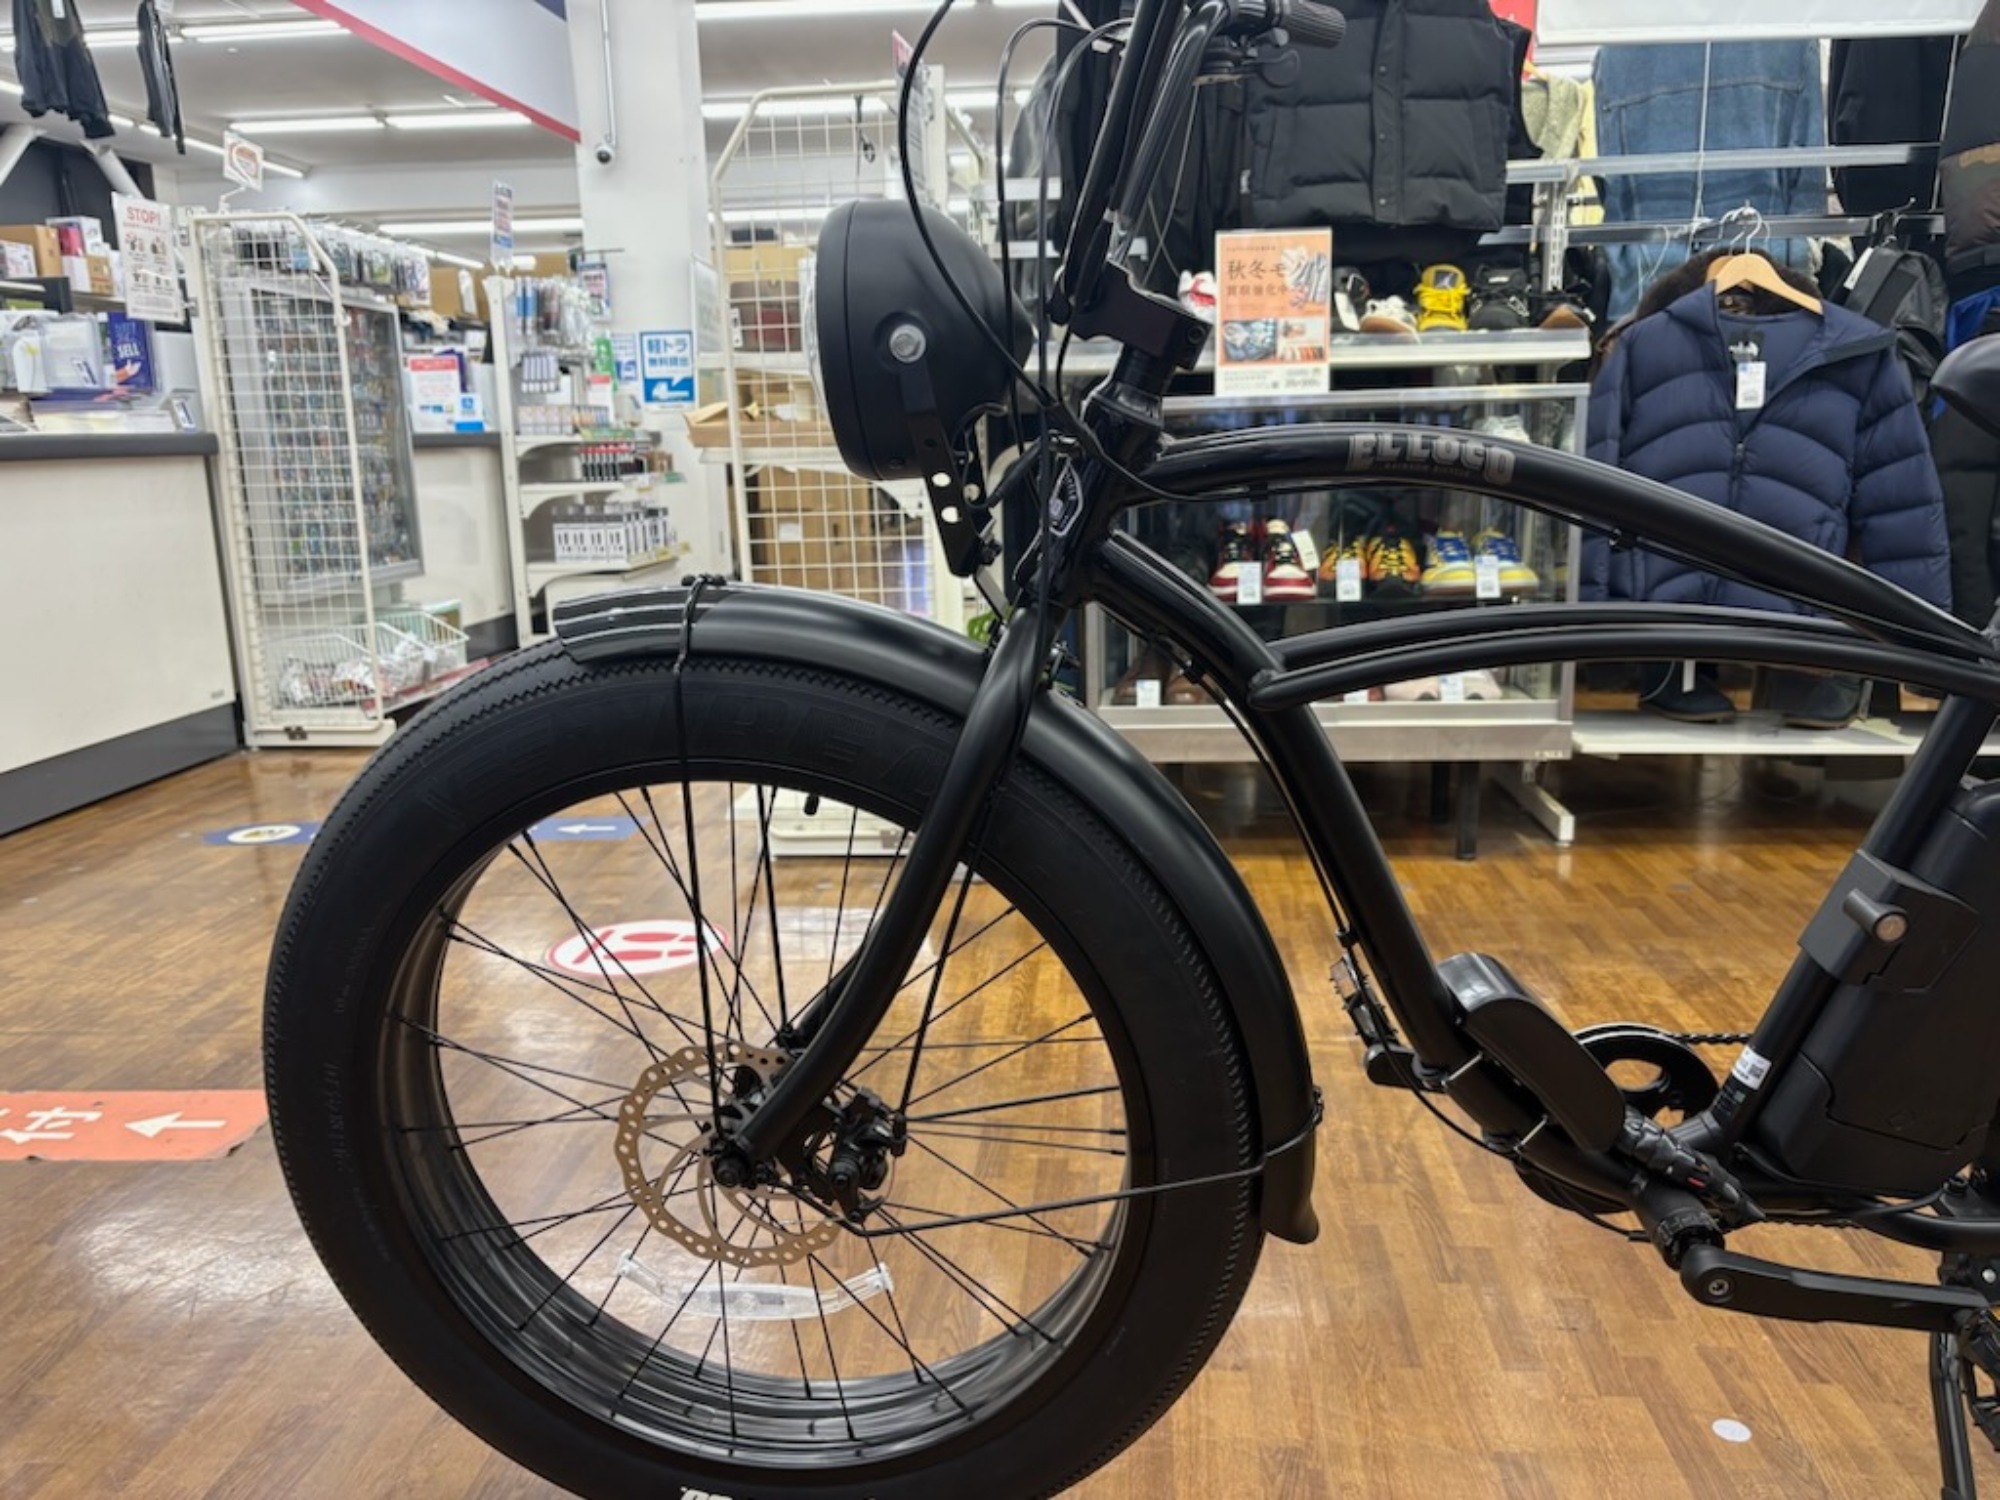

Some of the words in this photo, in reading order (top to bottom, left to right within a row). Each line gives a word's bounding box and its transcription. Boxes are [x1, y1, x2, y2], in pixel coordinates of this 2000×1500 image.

[126, 206, 162, 225] STOP!
[116, 342, 141, 358] SELL
[648, 337, 688, 354] 軽トラ
[0, 1105, 104, 1145] 付
